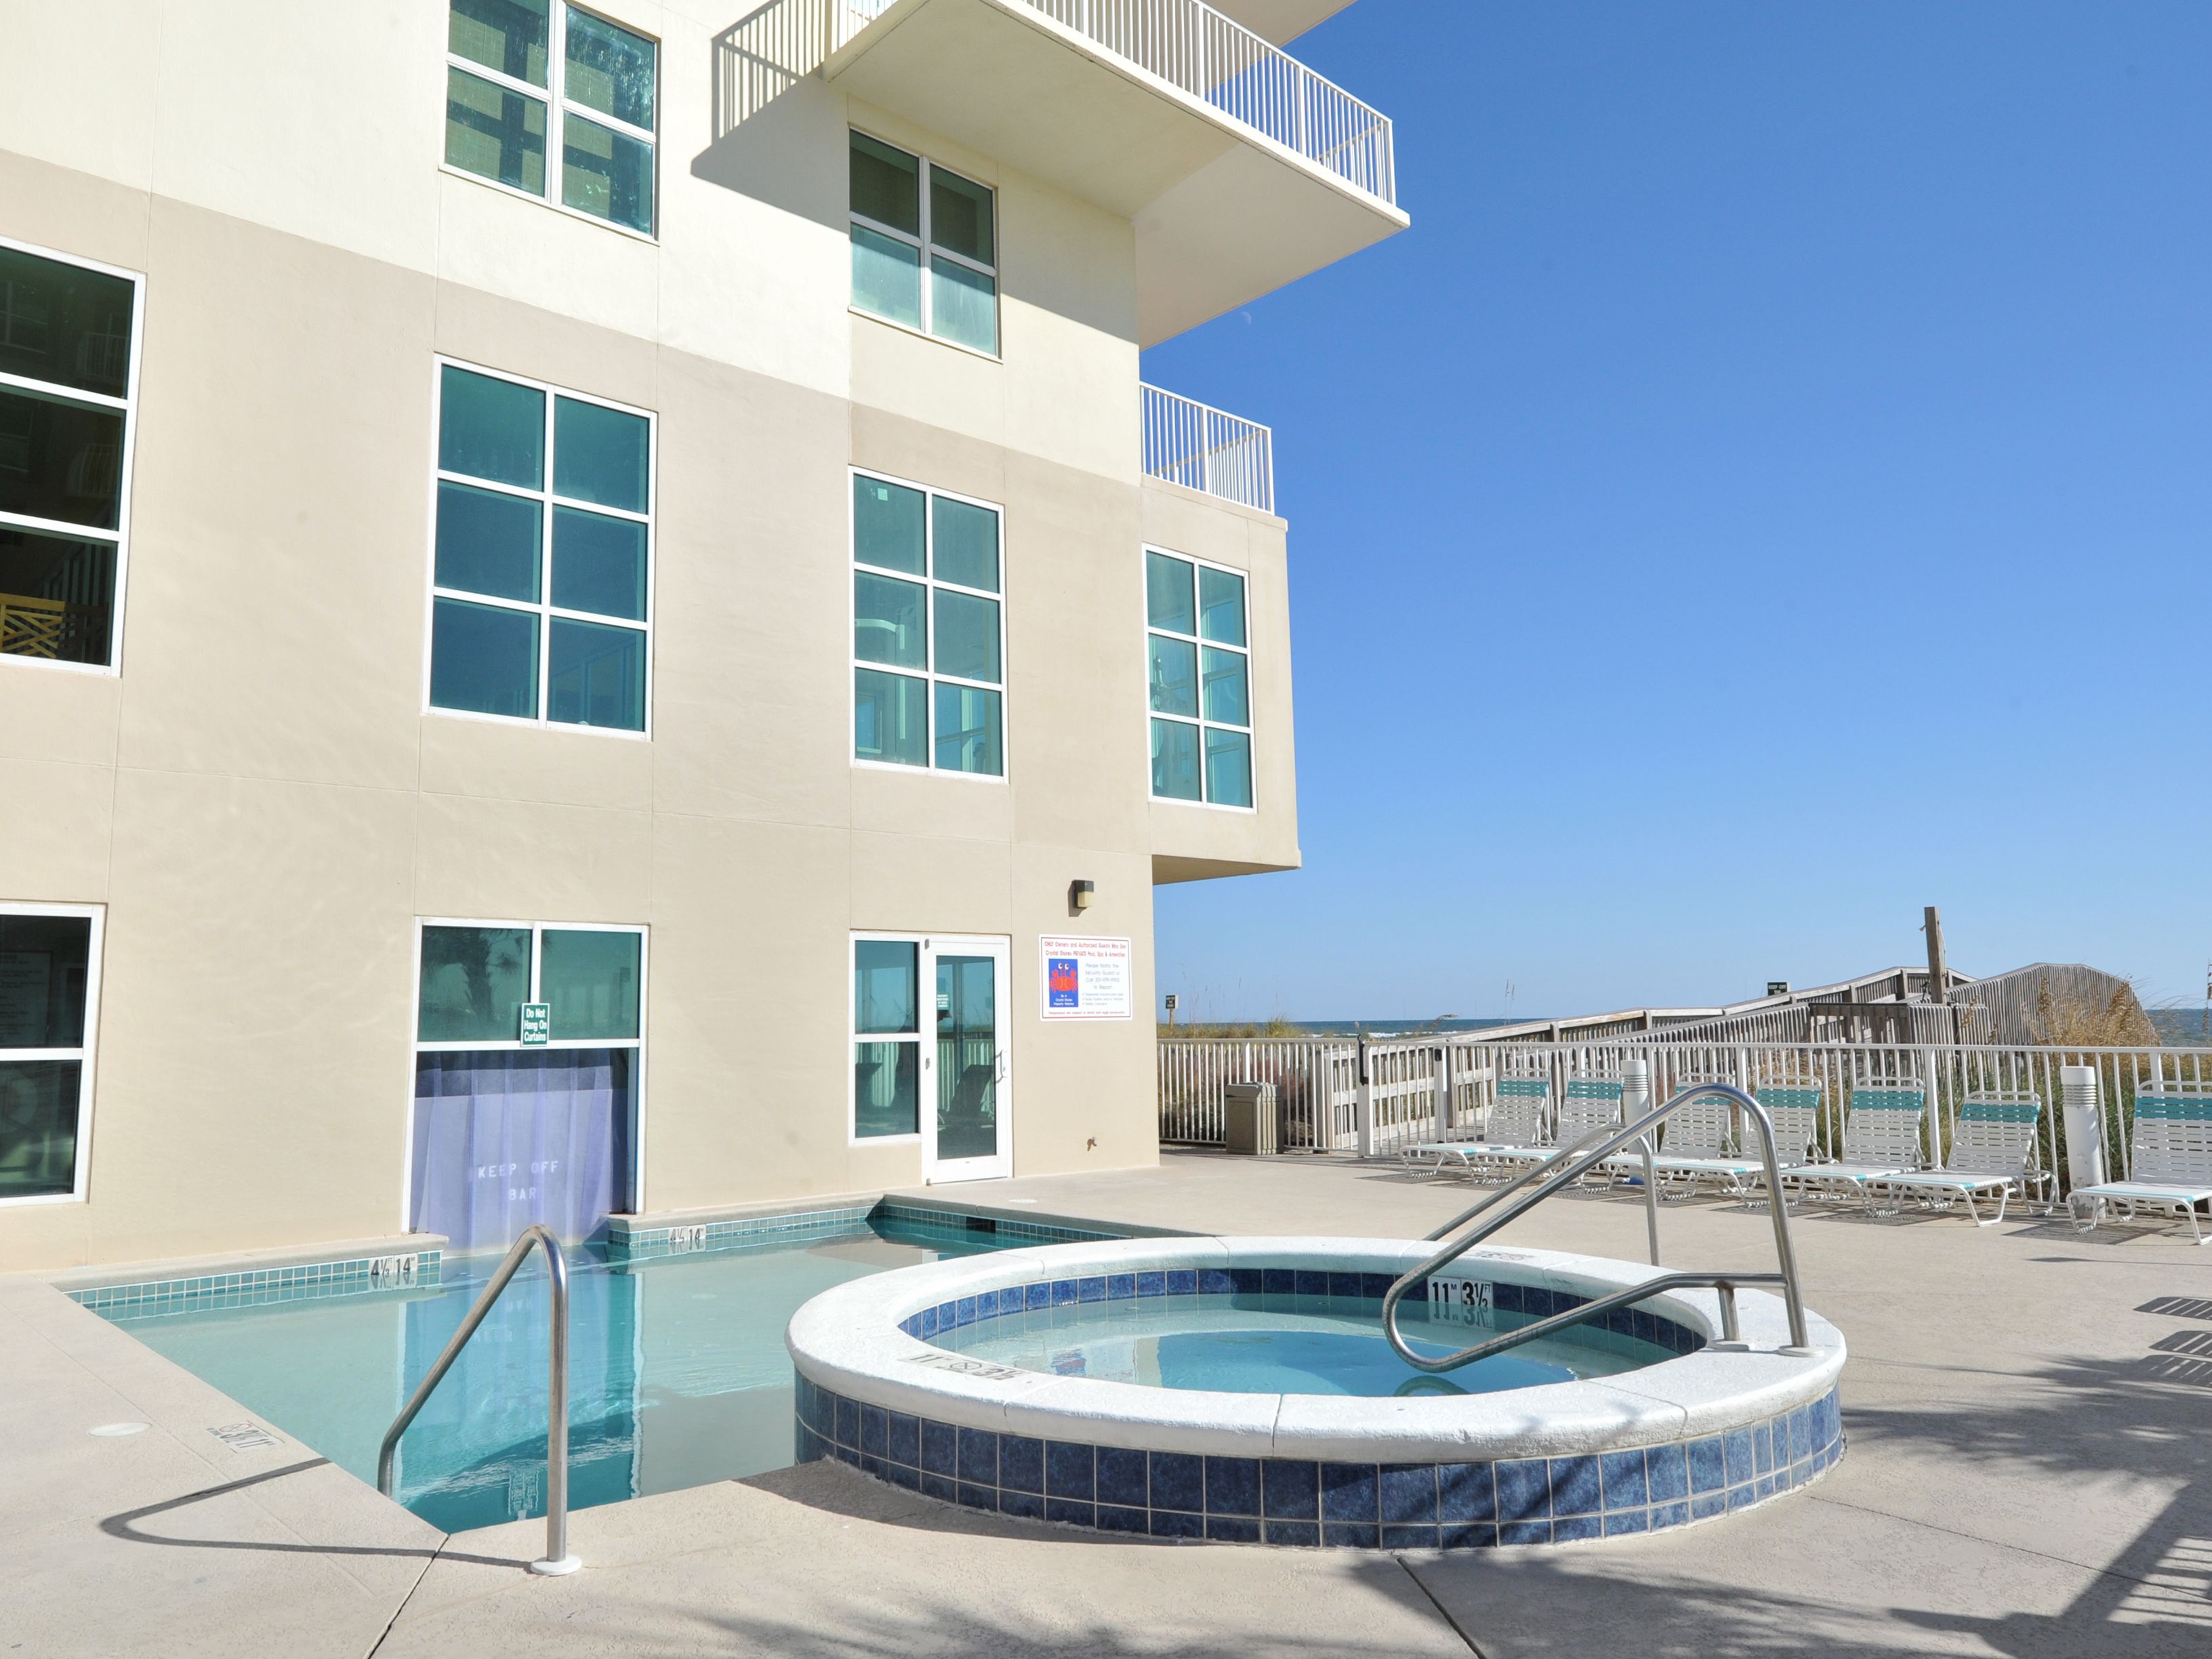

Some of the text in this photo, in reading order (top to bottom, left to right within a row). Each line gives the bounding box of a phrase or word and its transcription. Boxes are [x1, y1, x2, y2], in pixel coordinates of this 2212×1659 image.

[526, 1008, 546, 1018] Do Not
[524, 1019, 547, 1031] Hang On
[524, 1031, 546, 1042] Curtains
[478, 1160, 559, 1178] KEEP OFF
[509, 1187, 536, 1200] BAR
